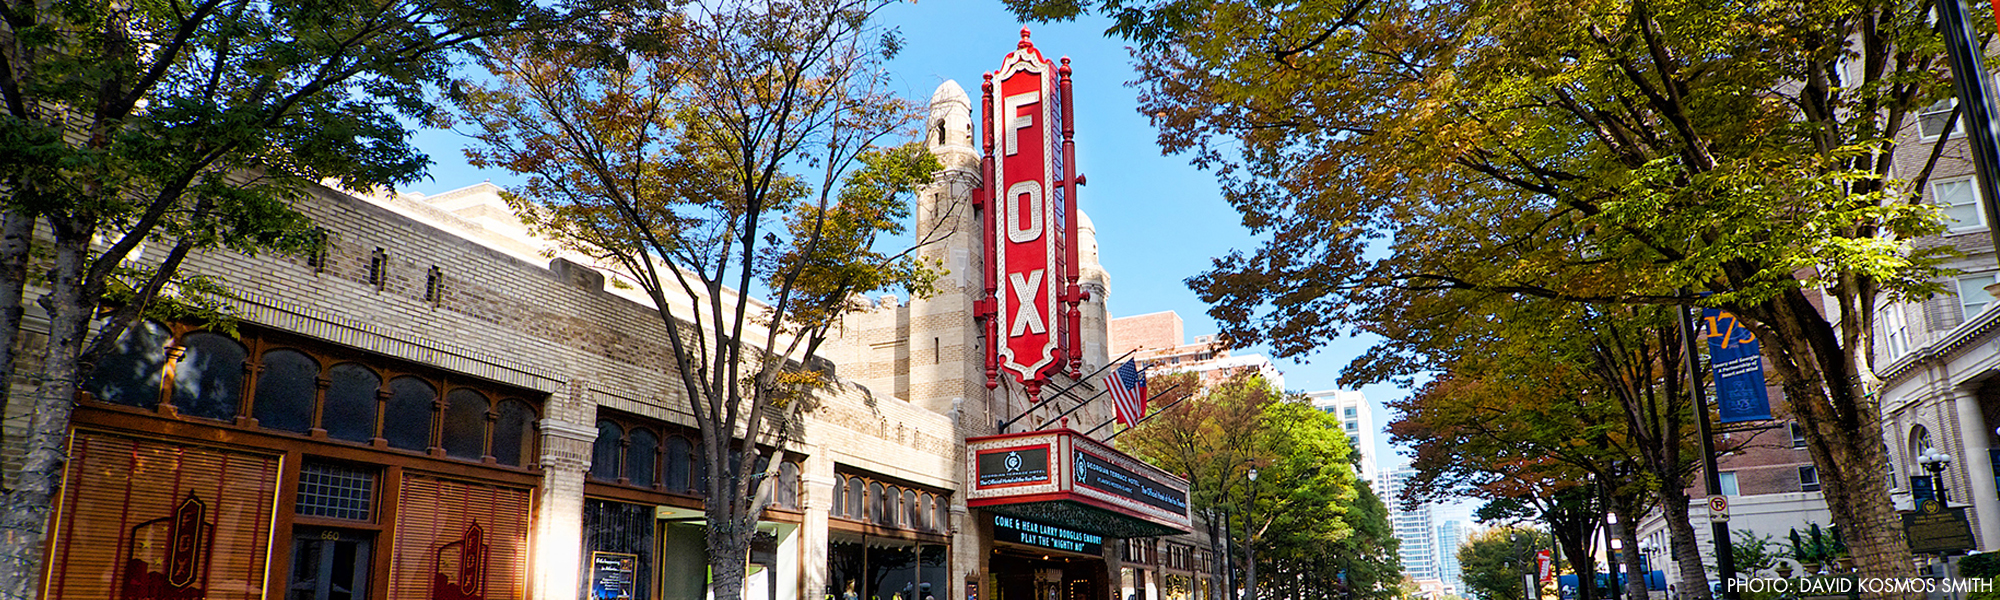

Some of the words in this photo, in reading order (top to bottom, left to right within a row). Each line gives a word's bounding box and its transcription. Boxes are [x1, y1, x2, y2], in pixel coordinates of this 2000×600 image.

[1004, 90, 1046, 338] FOX
[1087, 461, 1109, 475] GEORGIAN
[1109, 470, 1127, 482] TERRACE
[1128, 477, 1140, 487] HOTEL
[322, 530, 339, 540] 660
[995, 515, 1013, 528] COME
[1015, 519, 1020, 530] &
[1022, 520, 1038, 533] HEAR
[1040, 524, 1058, 537] LARRY
[1059, 528, 1082, 541] DOUGLAS
[1021, 532, 1036, 544] PLAY
[1038, 535, 1049, 546] THE
